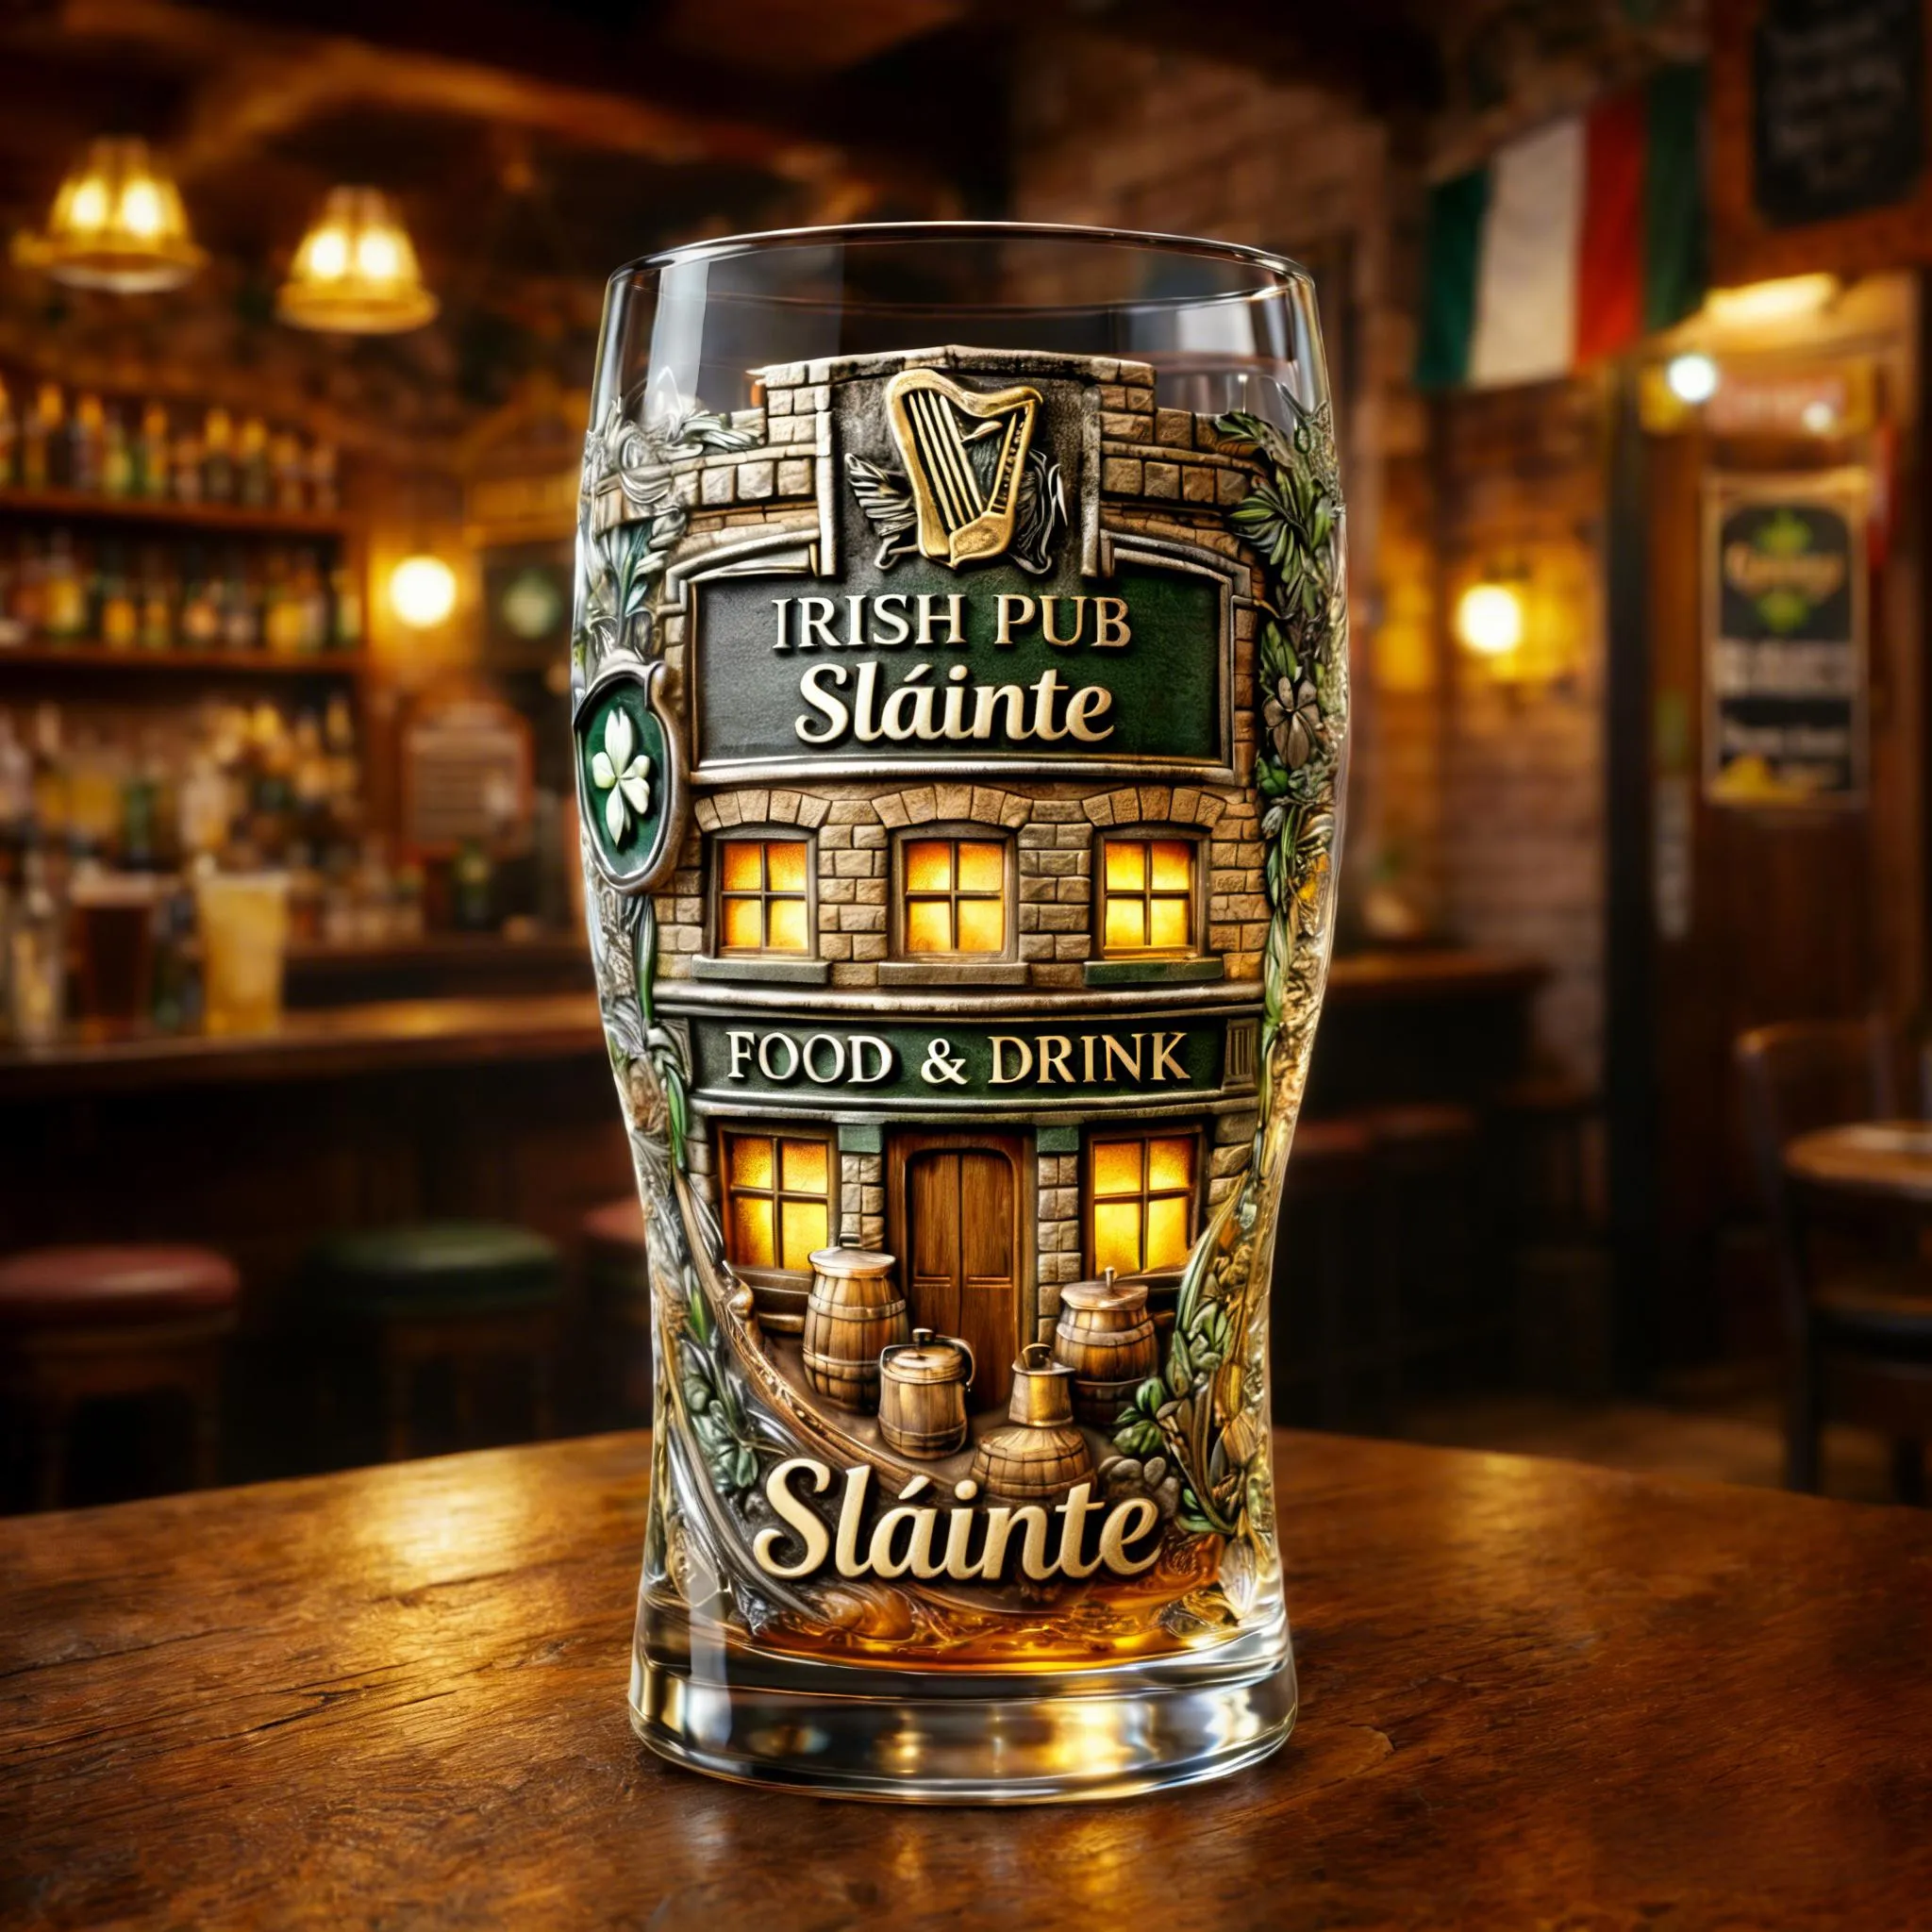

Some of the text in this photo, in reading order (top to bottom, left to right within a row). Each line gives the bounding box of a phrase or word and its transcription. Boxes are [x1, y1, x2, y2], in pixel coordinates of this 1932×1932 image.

[772, 594, 1131, 649] IRISH PUB
[794, 661, 1115, 743] Sláinte
[725, 1031, 1191, 1085] FOOD & DRINK
[754, 1457, 1162, 1580] Sláinte
